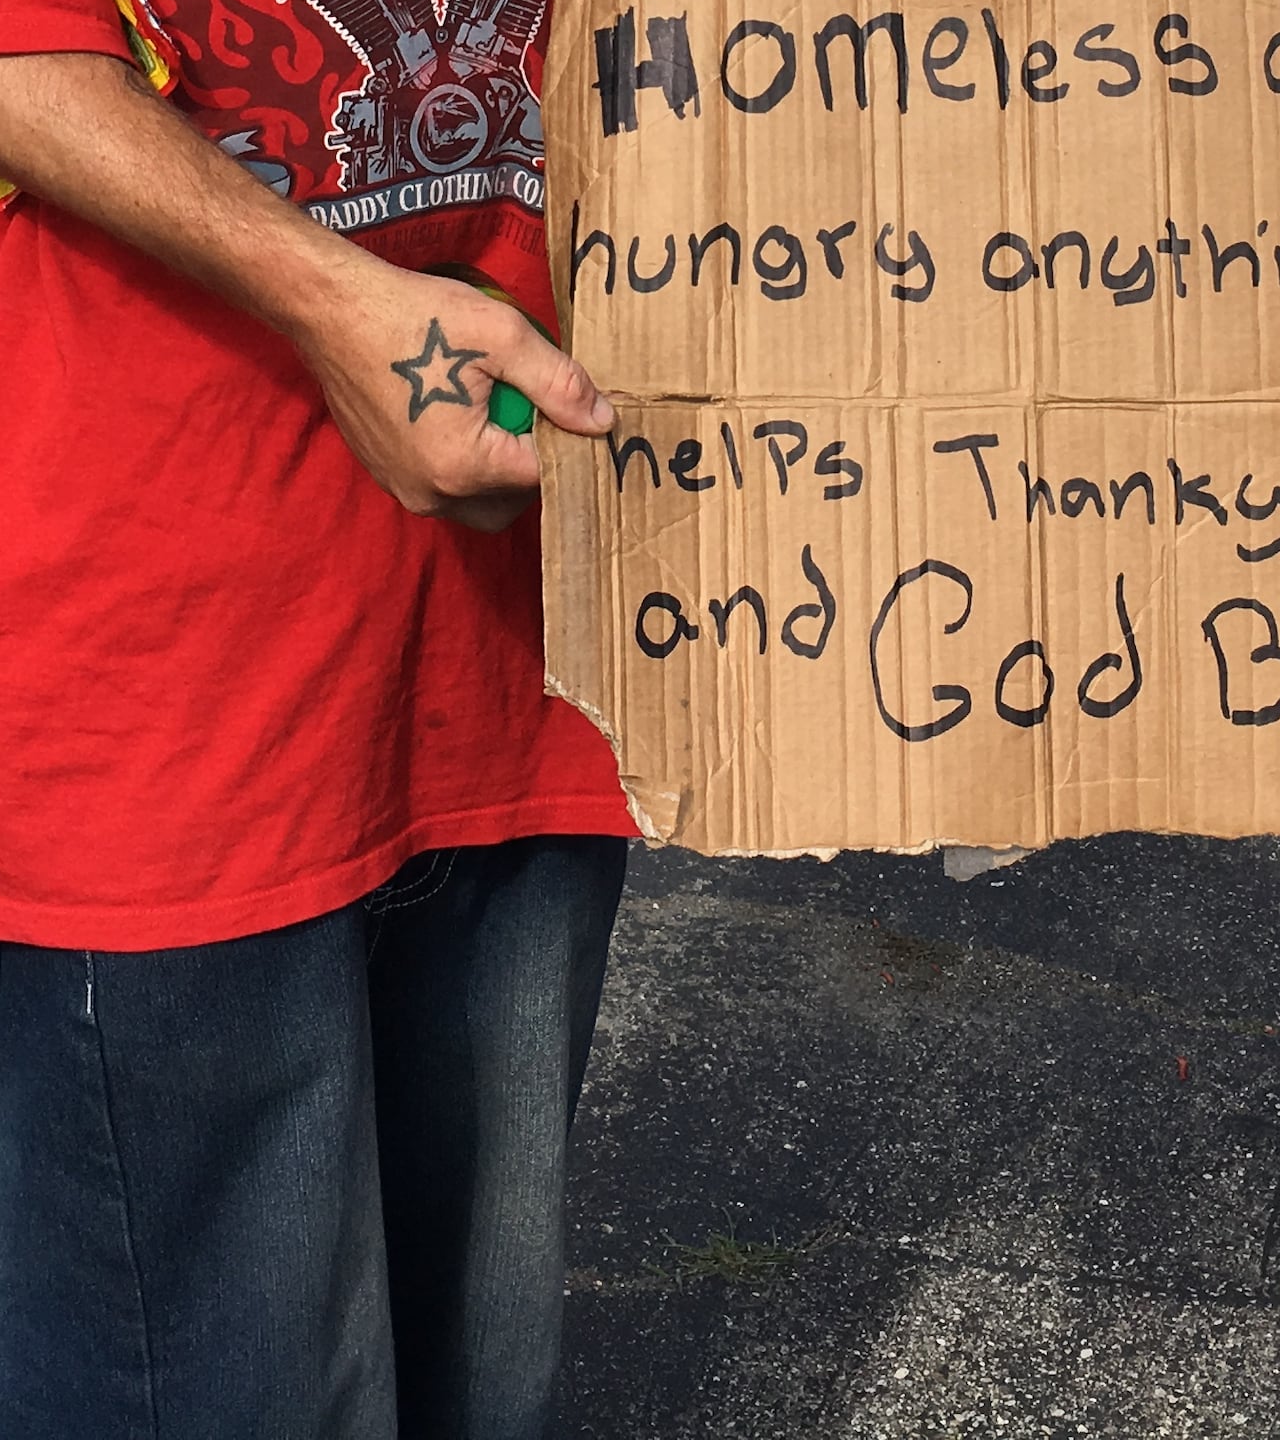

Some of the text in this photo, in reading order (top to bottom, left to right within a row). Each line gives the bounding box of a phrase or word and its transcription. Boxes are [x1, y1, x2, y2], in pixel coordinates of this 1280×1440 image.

[309, 190, 393, 231] DADDY
[398, 166, 508, 213] CLOTHING
[568, 198, 937, 304] hungry
[634, 545, 837, 660] and
[868, 558, 1144, 743] God
